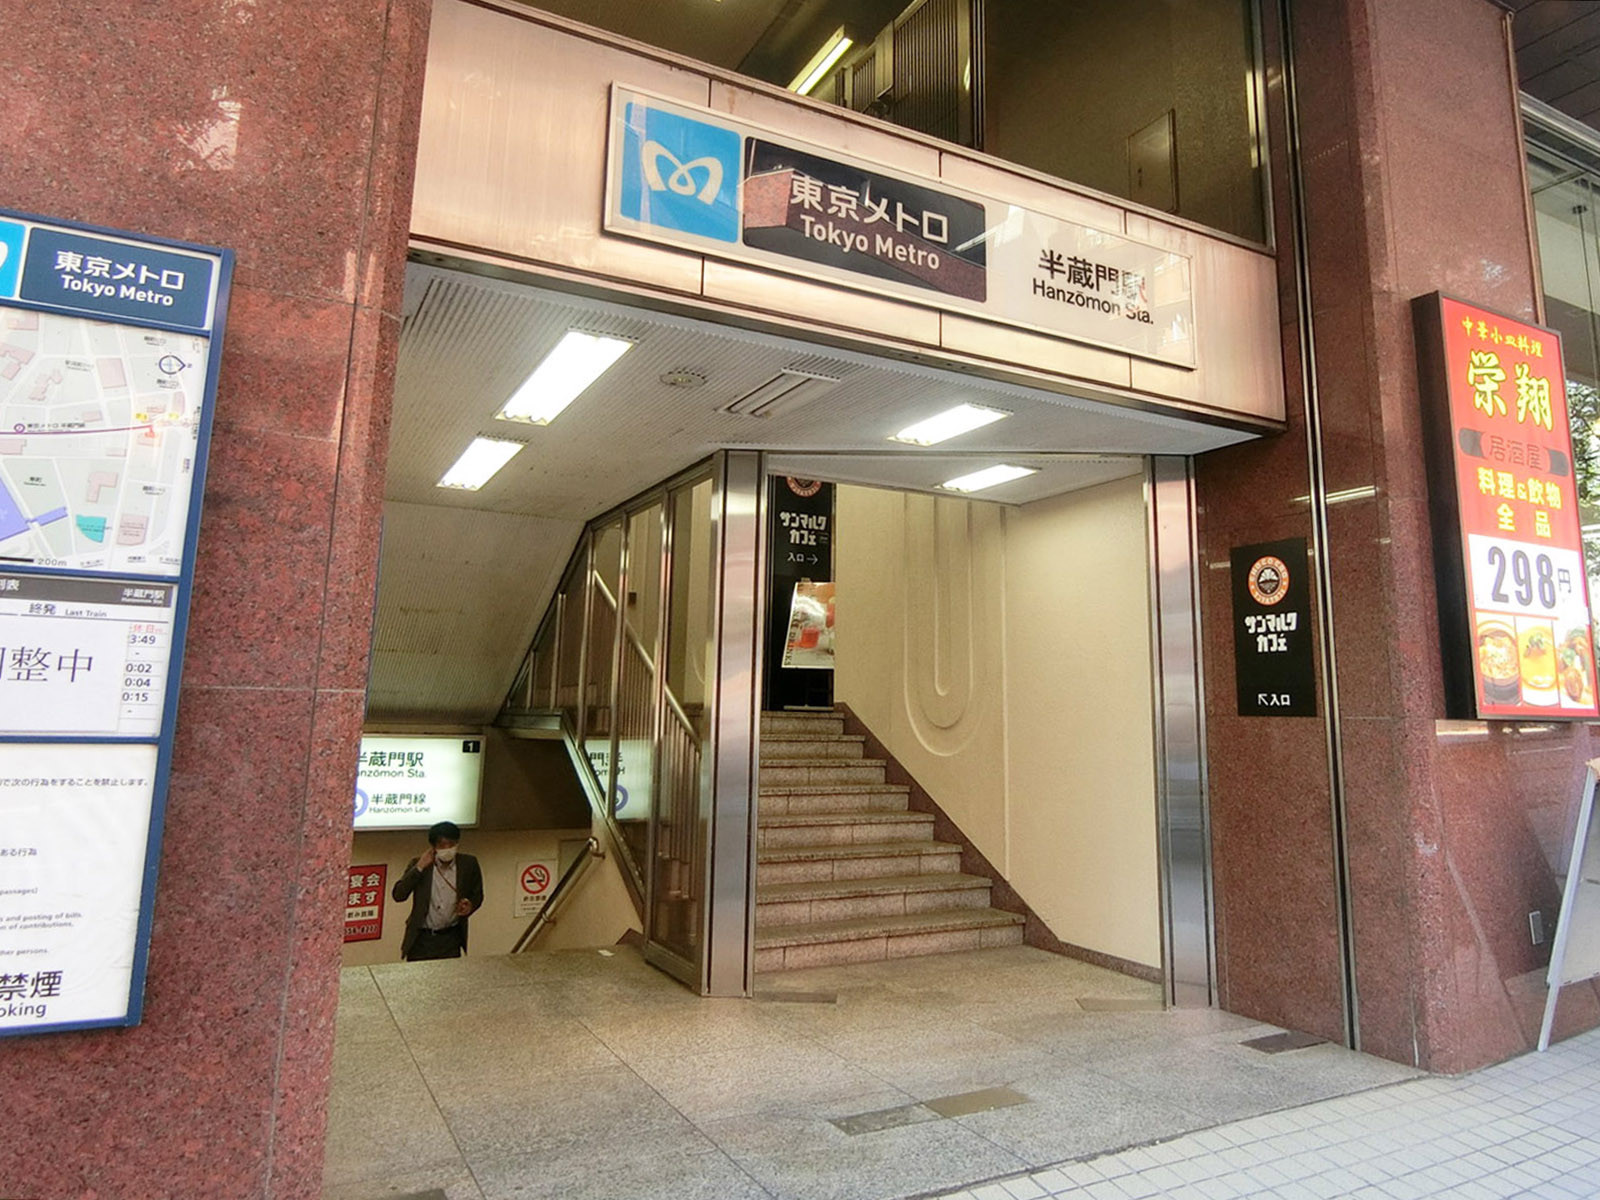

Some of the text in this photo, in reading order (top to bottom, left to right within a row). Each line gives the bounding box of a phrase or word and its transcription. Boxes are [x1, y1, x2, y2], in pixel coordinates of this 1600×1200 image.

[790, 173, 949, 245] 東京メトロ
[800, 213, 941, 271] Tokyo Metro
[54, 250, 185, 291] 東京メトロ
[60, 274, 174, 307] Tokyo Metro
[1489, 434, 1544, 471] 居酒屋
[780, 511, 827, 531] サンマルク
[789, 529, 817, 546] カフェ
[786, 551, 804, 562] 入口
[65, 608, 108, 618] Last Train
[1244, 612, 1298, 634] サンマルク
[1256, 633, 1288, 652] カフェ
[0, 647, 93, 683] 整中
[124, 677, 151, 687] 0:04
[121, 691, 149, 702] 0:15
[1270, 693, 1291, 706] 入口
[371, 793, 427, 805] 半蔵門線
[0, 970, 64, 1001] 禁煙
